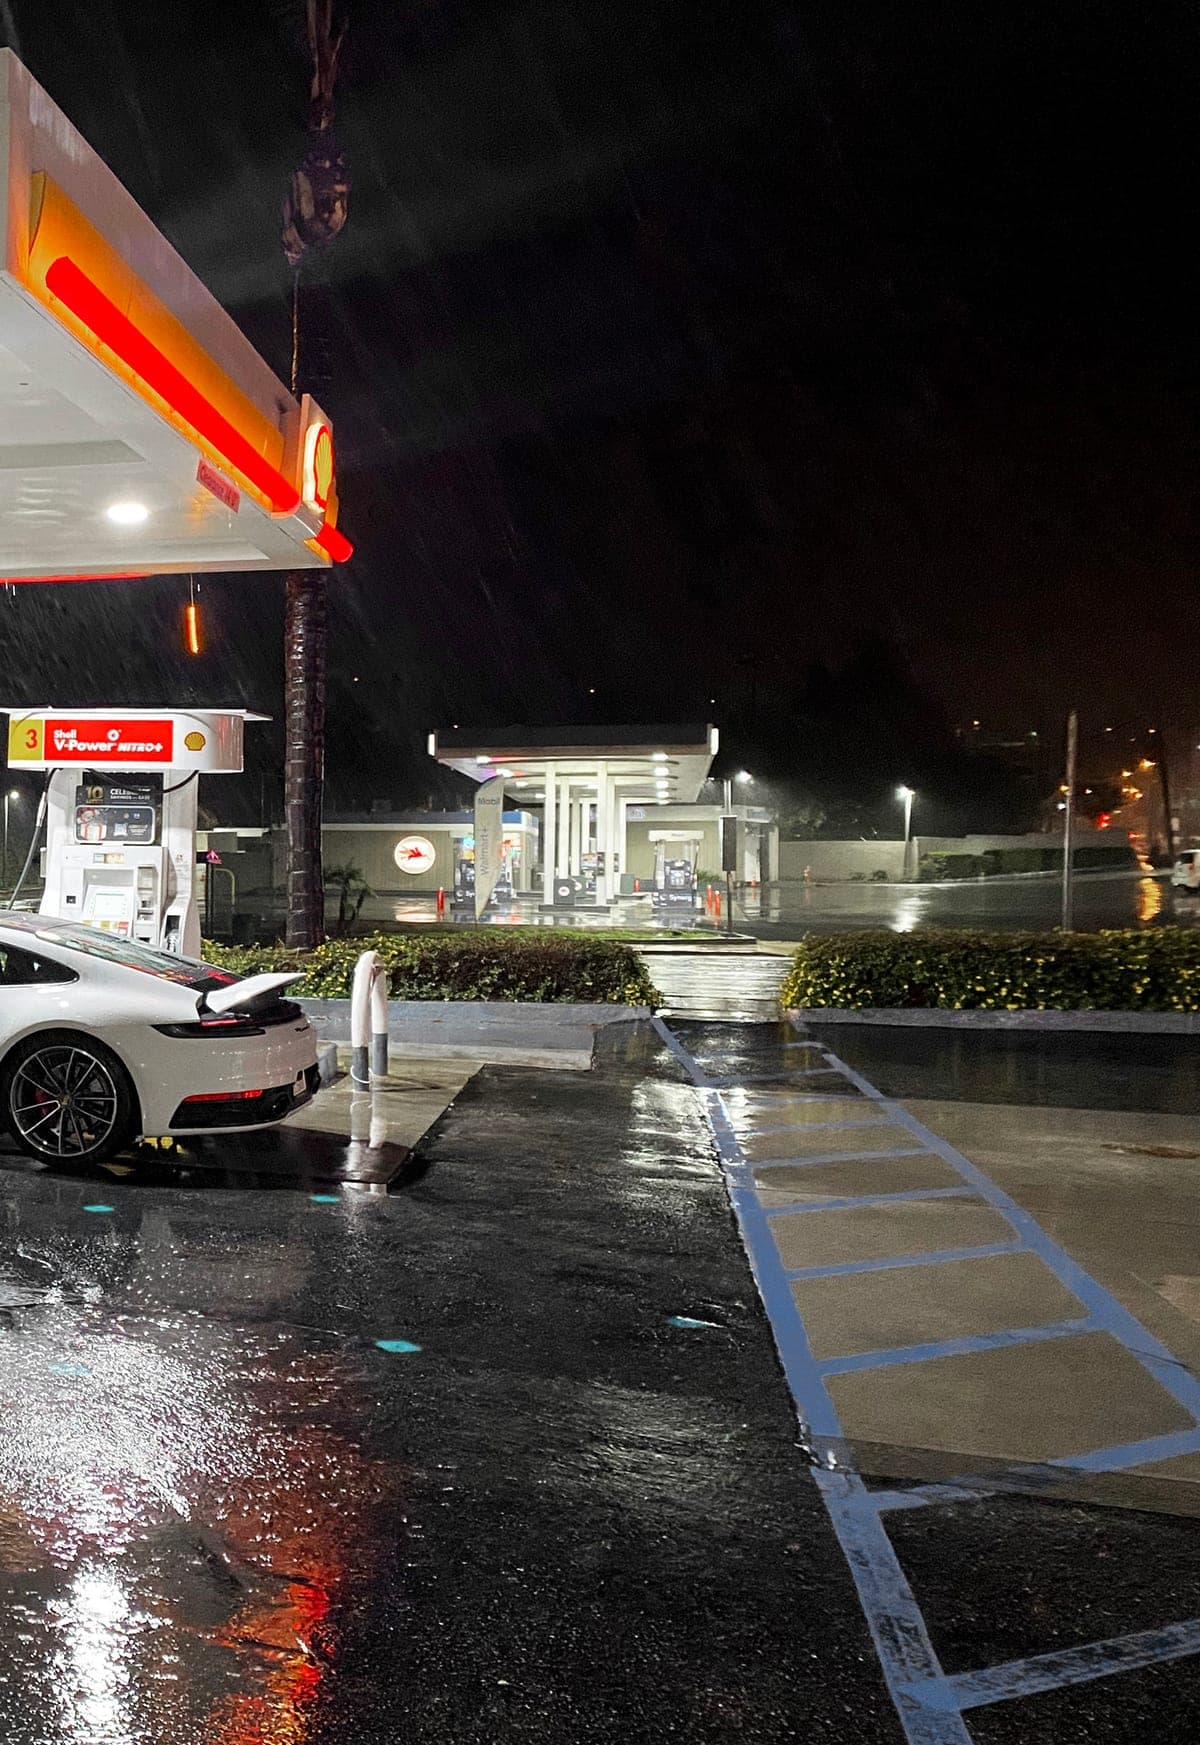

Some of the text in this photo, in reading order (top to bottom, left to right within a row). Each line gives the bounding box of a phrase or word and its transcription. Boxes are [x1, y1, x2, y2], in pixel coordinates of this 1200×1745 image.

[25, 729, 37, 749] 3
[53, 729, 77, 739] Shell
[54, 739, 163, 752] V-Power NITRO+
[86, 786, 104, 799] 10
[480, 825, 490, 876] Walmart+
